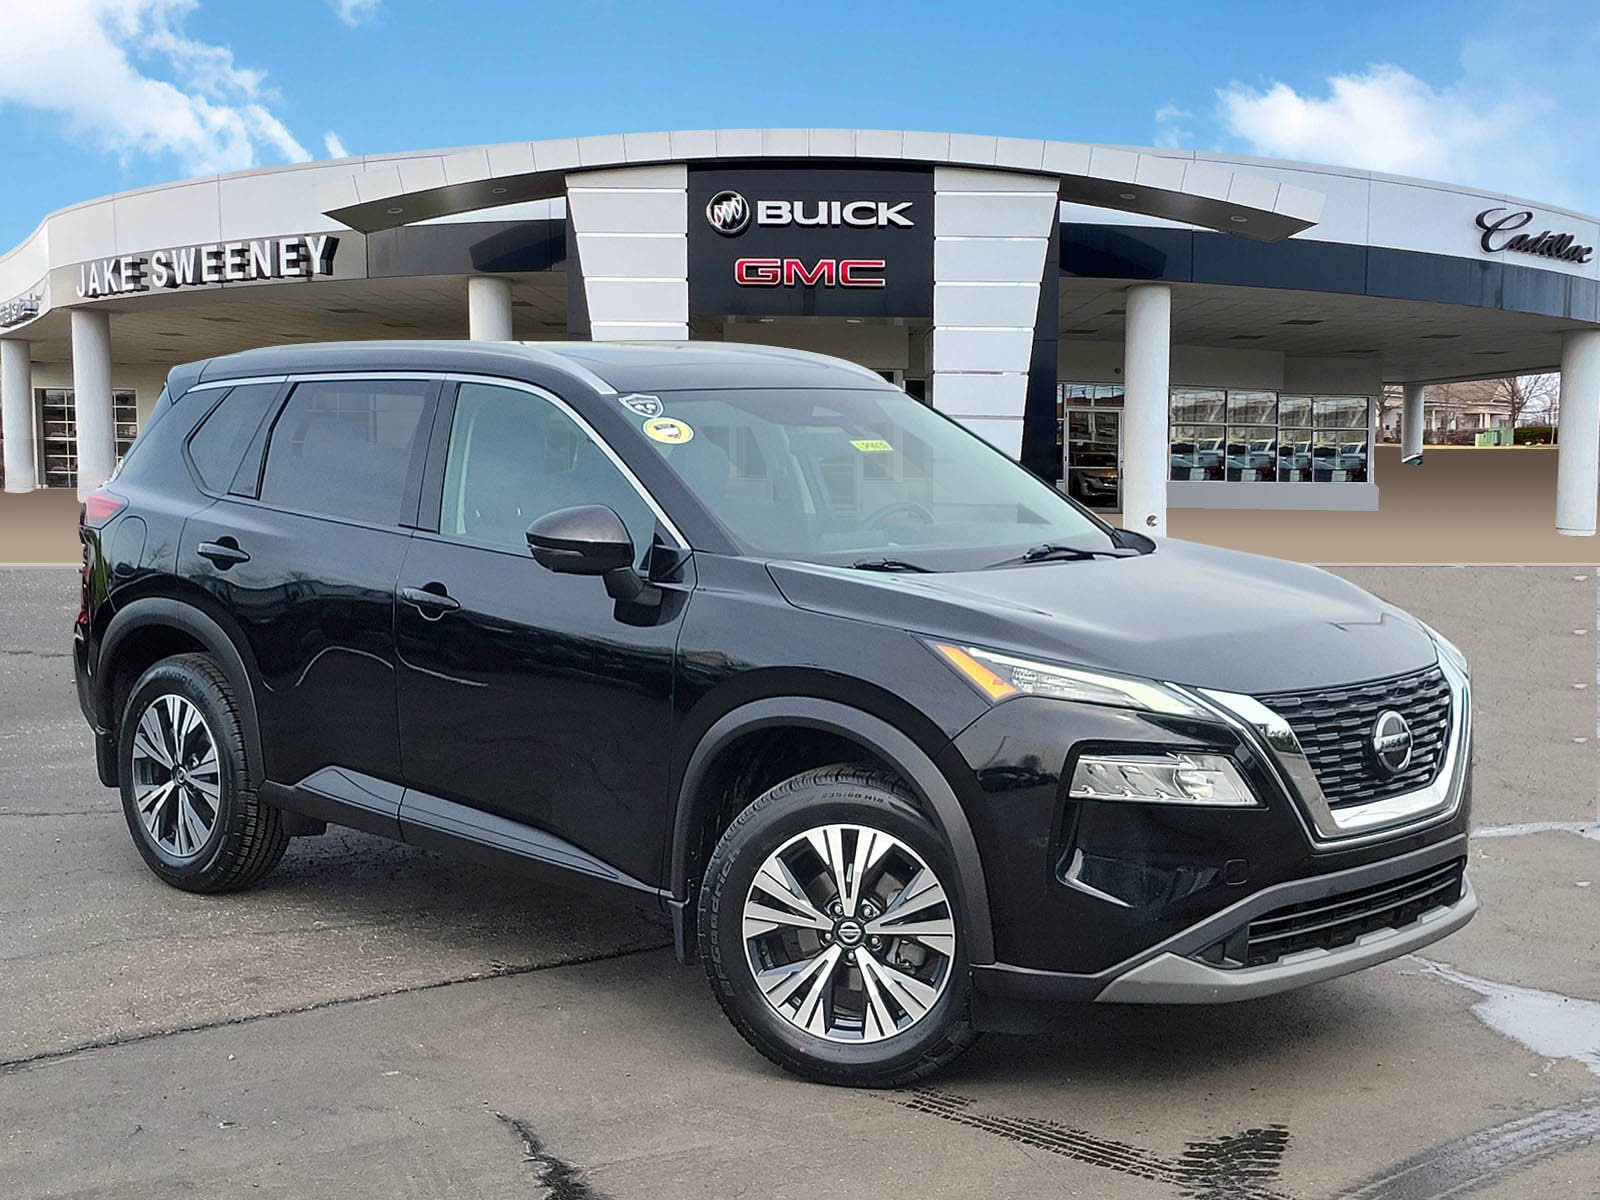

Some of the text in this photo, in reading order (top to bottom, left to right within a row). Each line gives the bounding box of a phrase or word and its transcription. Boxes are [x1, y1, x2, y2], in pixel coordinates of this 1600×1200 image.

[757, 200, 915, 226] BUICK
[1475, 207, 1593, 263] Cadillac
[76, 235, 338, 298] JAKE SWEENEY
[735, 258, 886, 287] GMC
